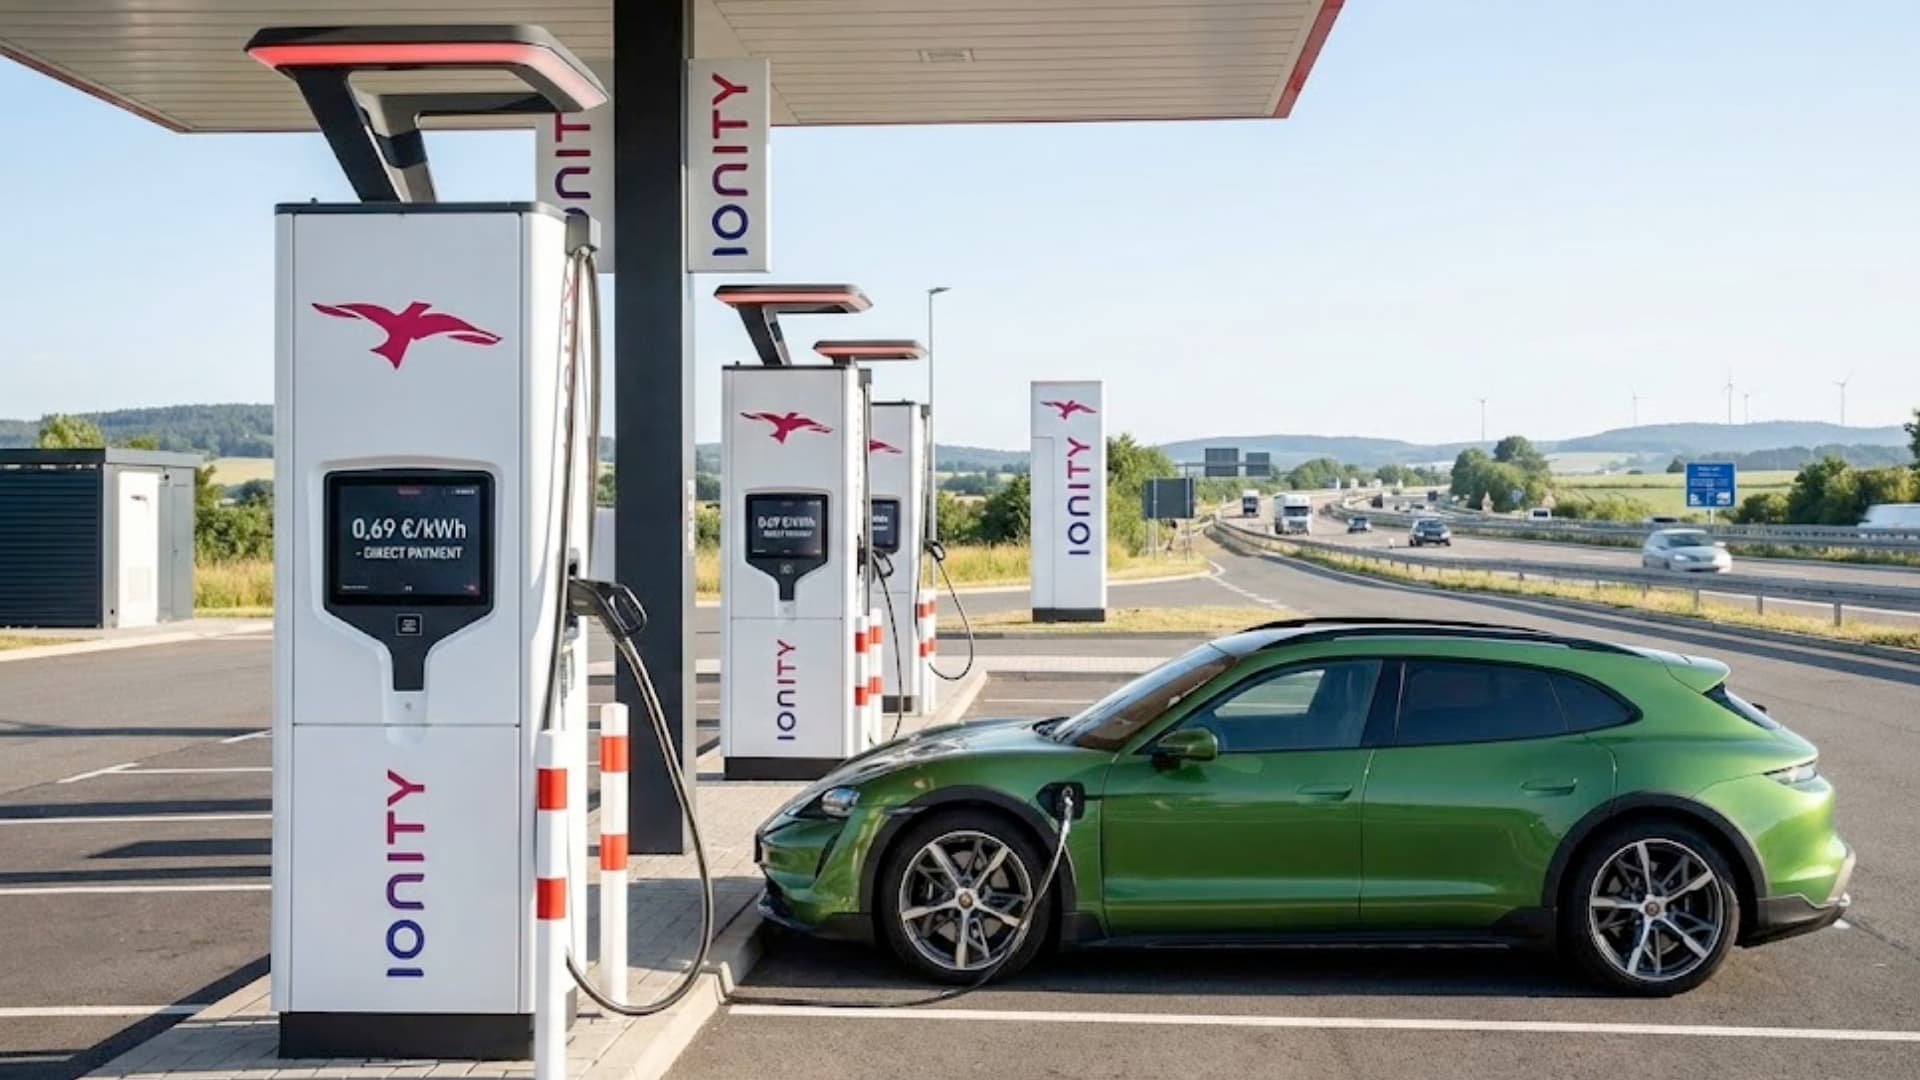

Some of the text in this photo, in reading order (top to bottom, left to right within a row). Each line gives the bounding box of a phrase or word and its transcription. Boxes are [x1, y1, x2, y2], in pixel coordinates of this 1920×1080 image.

[554, 112, 592, 215] NIT
[712, 72, 749, 256] IONITY
[352, 518, 467, 540] 0,69 €/kWh
[1067, 437, 1091, 556] IONITY
[776, 639, 797, 741] IONITY
[386, 769, 426, 978] IONITY
